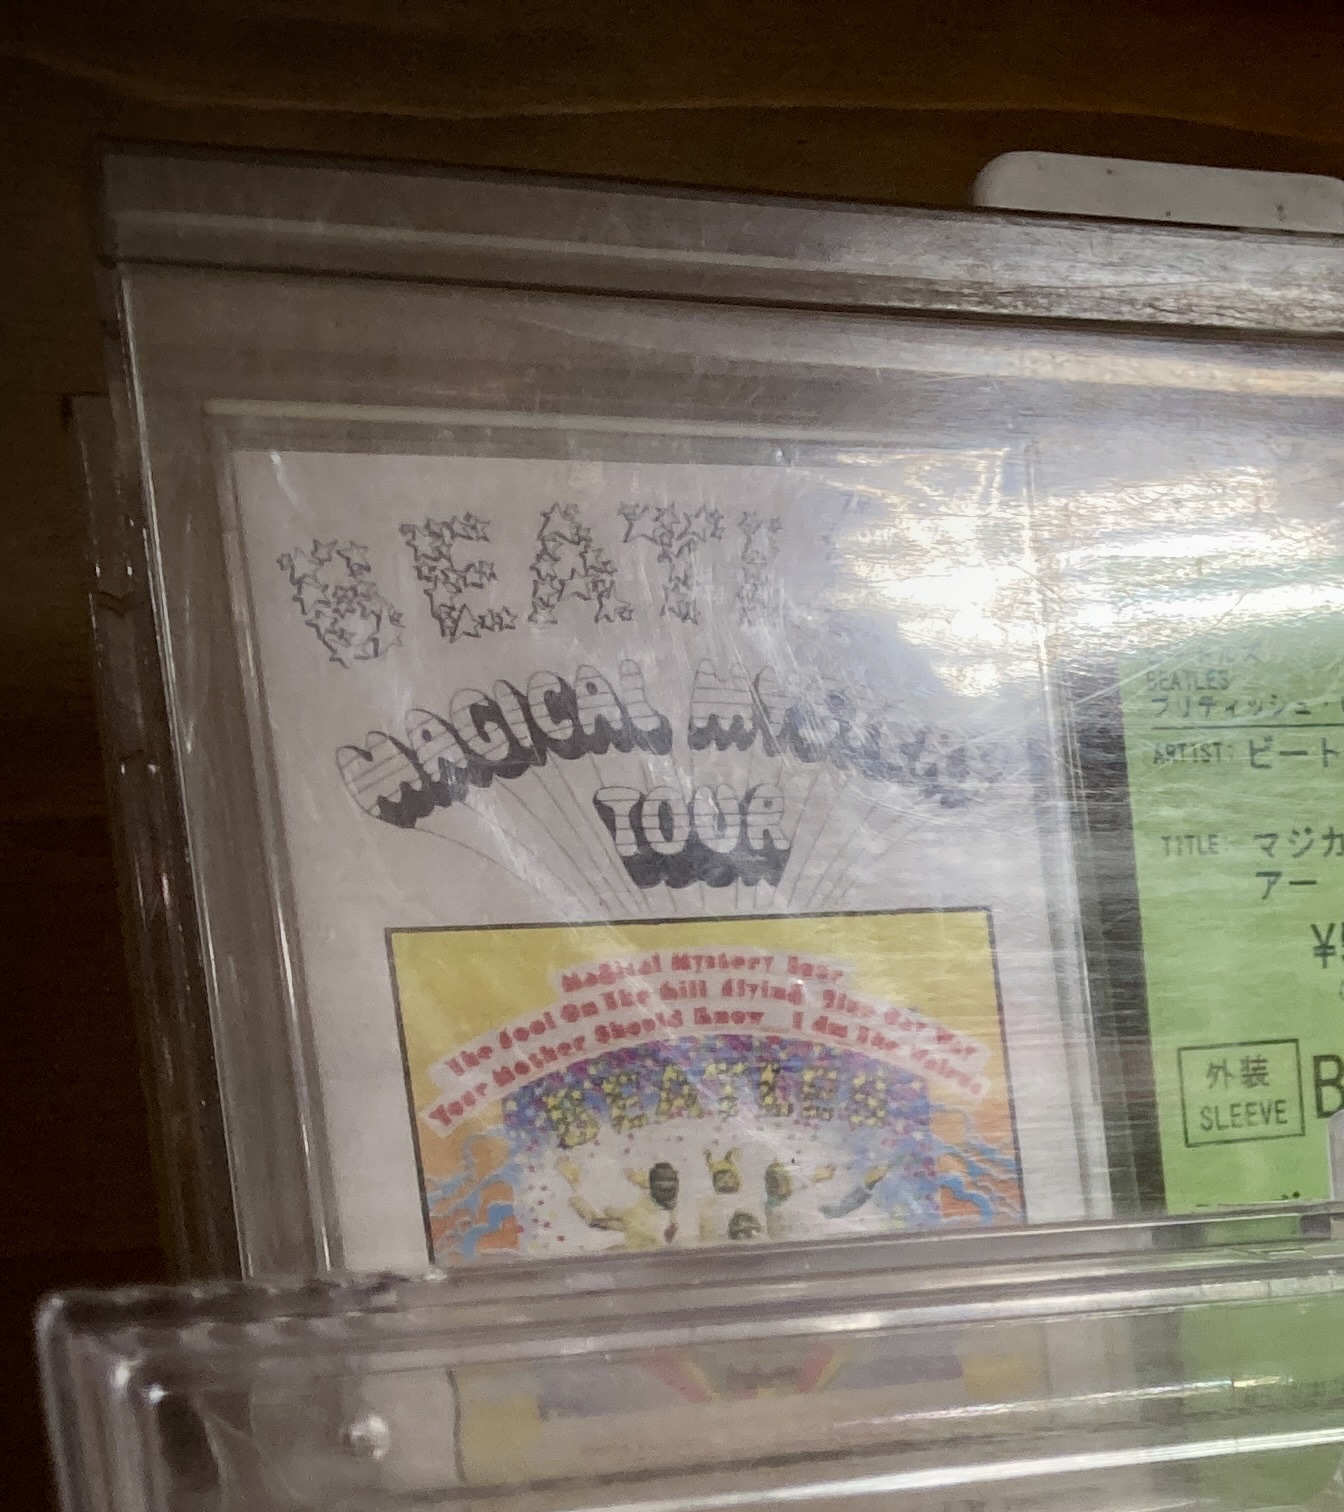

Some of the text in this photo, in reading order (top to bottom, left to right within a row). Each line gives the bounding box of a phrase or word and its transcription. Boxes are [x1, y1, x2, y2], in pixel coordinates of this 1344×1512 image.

[335, 658, 673, 829] MAGICAL
[593, 783, 794, 888] TOUR
[1200, 1104, 1289, 1132] SLEEVE
